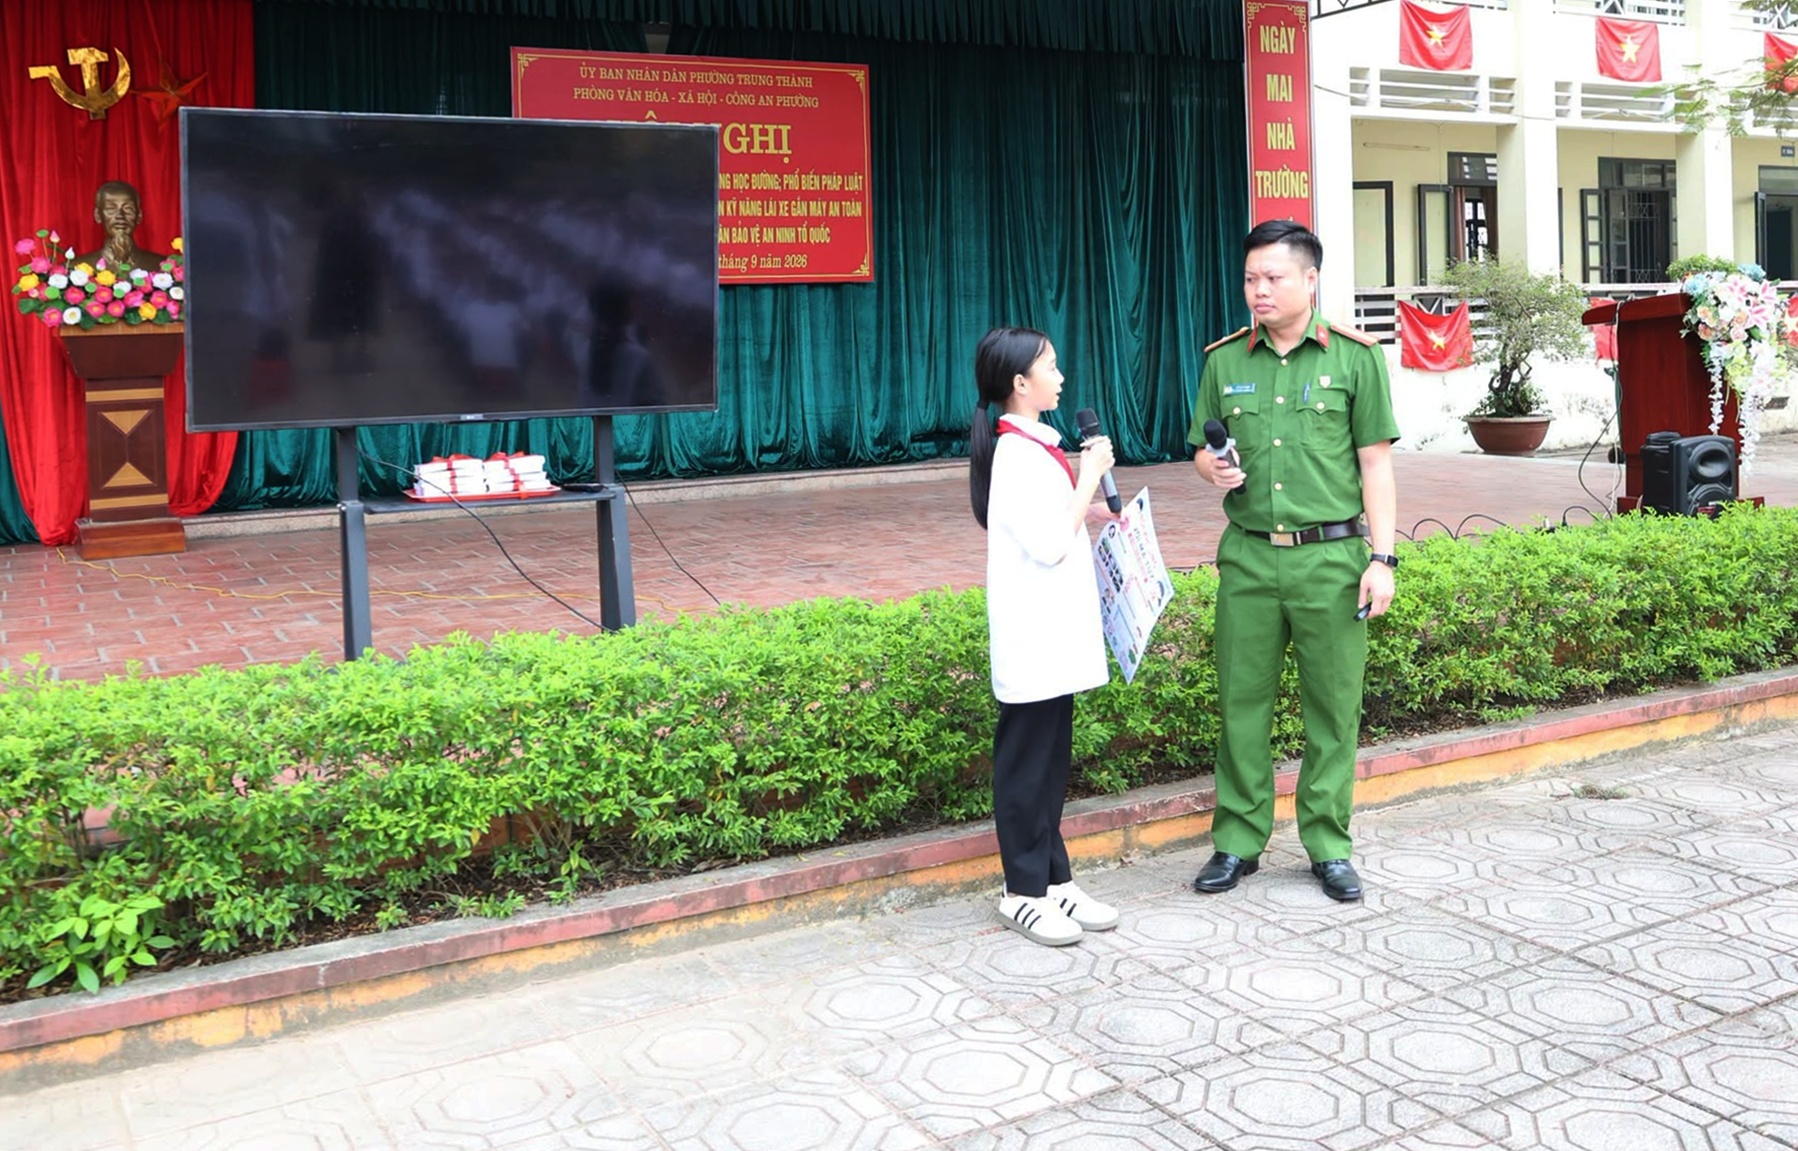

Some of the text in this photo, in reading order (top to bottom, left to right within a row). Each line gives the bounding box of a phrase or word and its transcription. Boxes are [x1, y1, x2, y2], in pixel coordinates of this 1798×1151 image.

[1259, 21, 1296, 54] NGÀY
[579, 61, 813, 88] ỦY BAN NHÂN DÂN PHƯỜNG TRUNG THÀNH
[573, 84, 614, 101] PHÒNG
[616, 87, 642, 102] VĂN
[644, 88, 669, 103] HÓA
[697, 90, 718, 106] HỘI
[726, 92, 756, 106] CÔNG
[757, 95, 774, 107] AN
[776, 94, 819, 109] PHƯỜNG
[1266, 74, 1293, 103] MAI
[1266, 118, 1296, 151] NHÀ
[732, 173, 749, 193] HỌC
[783, 168, 800, 190] PHỔ
[801, 169, 820, 190] BIẾN
[821, 172, 843, 191] PHÁP
[844, 172, 863, 194] LUẬT
[1255, 164, 1309, 199] TRƯỜNG
[739, 197, 762, 217] NĂNG
[764, 197, 777, 217] LÁI
[778, 200, 789, 216] XE
[809, 197, 827, 217] MÁY
[828, 201, 840, 217] AN
[841, 198, 862, 217] TOÀN
[731, 221, 748, 244] BẢO
[750, 224, 760, 247] VỆ
[762, 227, 774, 243] AN
[776, 227, 796, 244] NINH
[797, 221, 808, 244] TỔ
[809, 221, 831, 245] QUỐC
[750, 254, 757, 269] 9
[759, 253, 781, 269] năm
[784, 254, 808, 268] 2026
